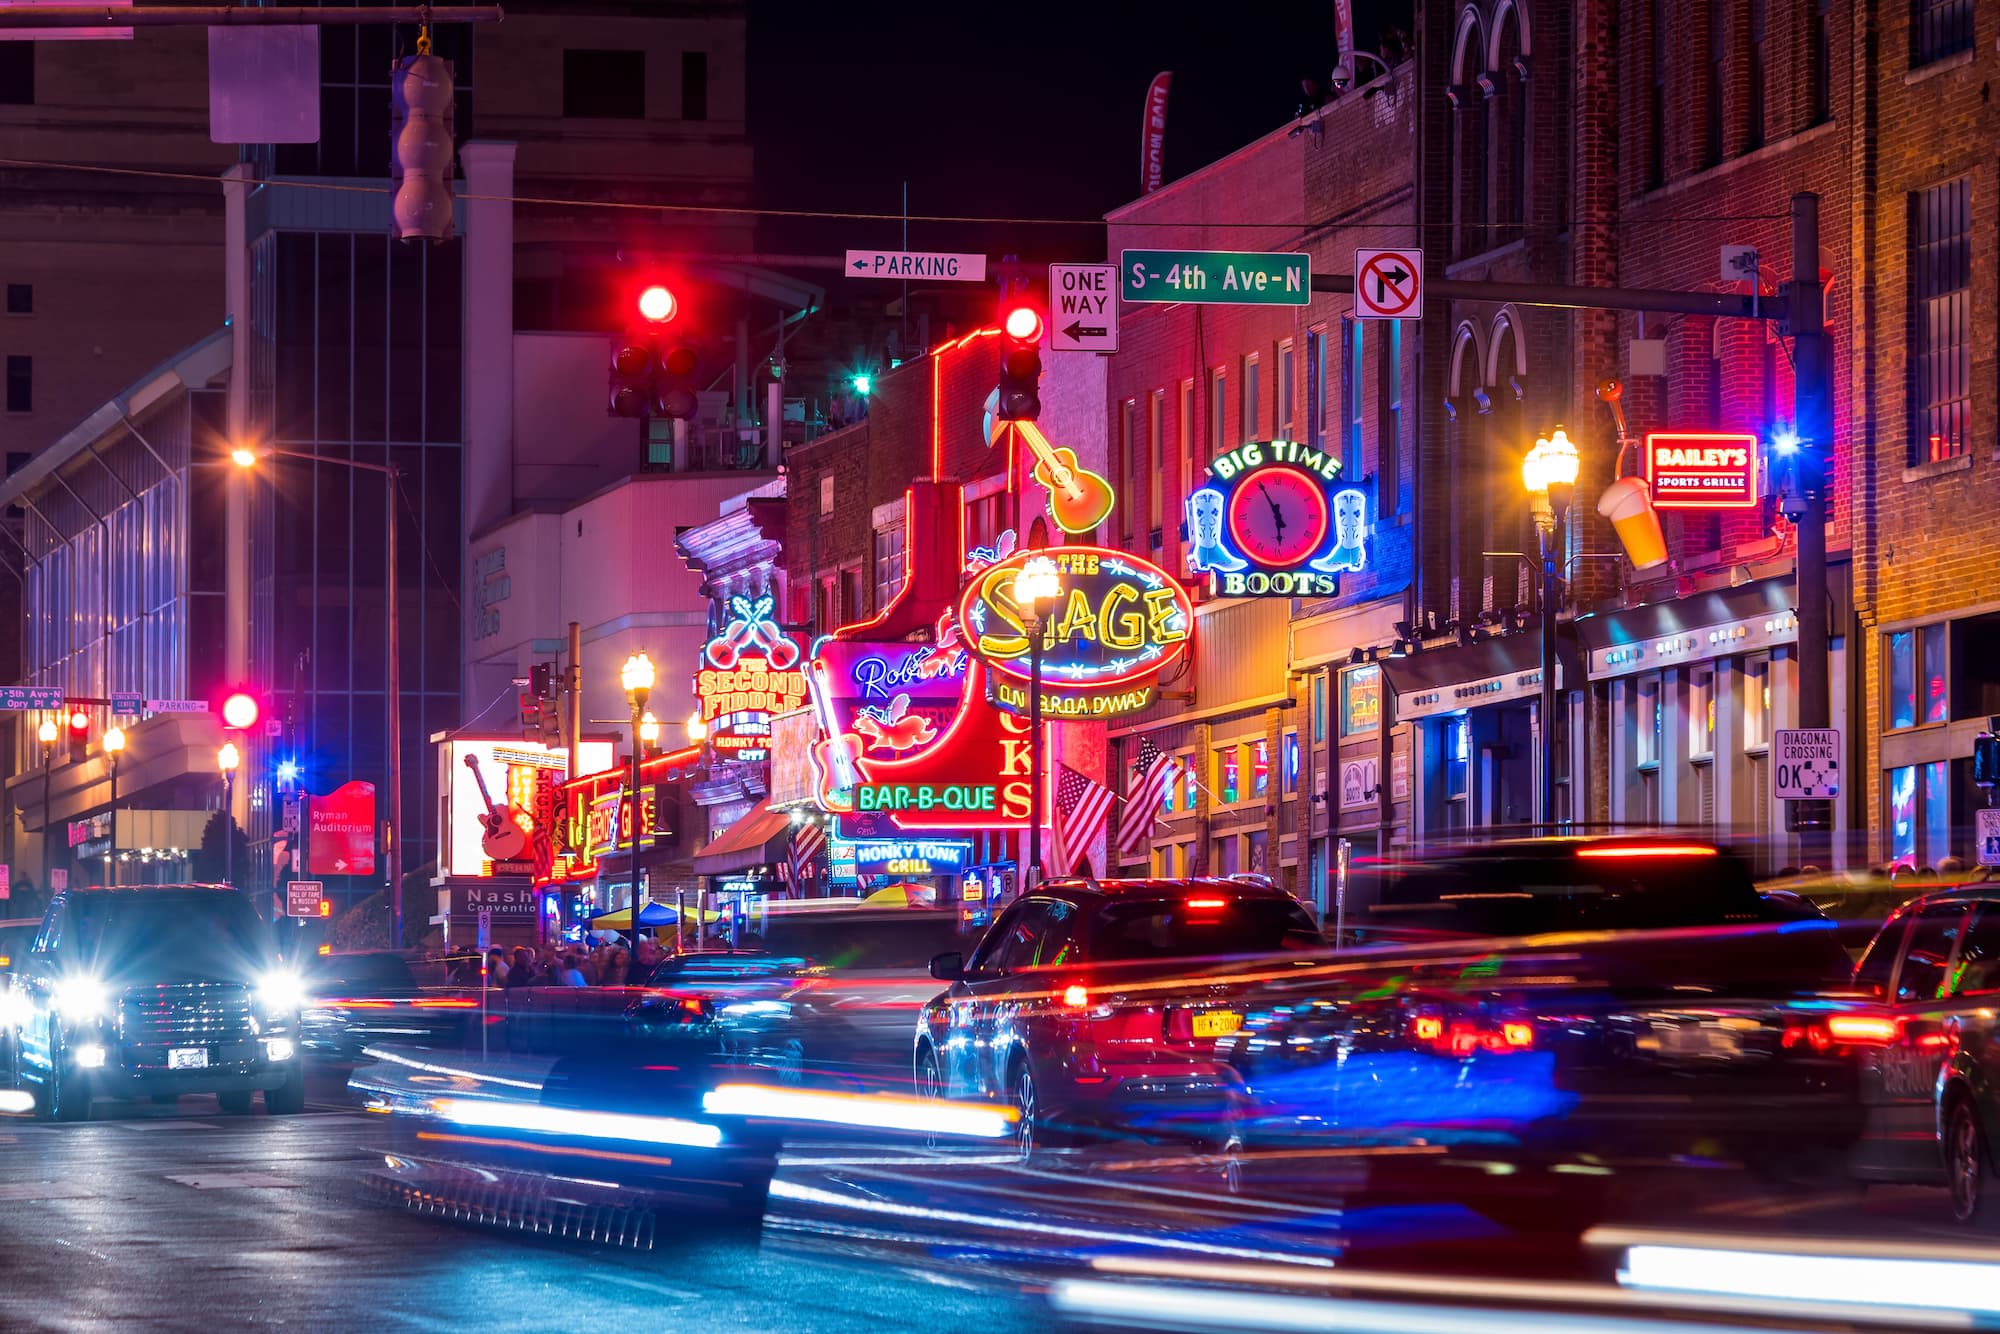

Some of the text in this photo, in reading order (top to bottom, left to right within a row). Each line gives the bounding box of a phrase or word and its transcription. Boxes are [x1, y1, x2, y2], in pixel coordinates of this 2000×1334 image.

[874, 254, 959, 277] PARKING
[1062, 271, 1108, 292] ONE
[1131, 262, 1302, 293] S-4th Ave-N
[1061, 295, 1108, 315] WAY
[1213, 440, 1343, 480] BIG TIME
[1655, 448, 1748, 467] BAILEY'S
[1657, 477, 1745, 487] SPORTS GRILLE
[1057, 553, 1100, 576] THE
[1223, 572, 1336, 594] BOOTS
[738, 658, 768, 672] THE
[698, 670, 807, 697] SECOND
[7, 699, 29, 709] Opry
[1000, 683, 1026, 708] ON
[159, 701, 197, 711] PARKING
[703, 691, 802, 721] FIDDLE
[715, 736, 773, 748] HONKY TO
[1784, 732, 1833, 745] DIAGONAL
[737, 749, 766, 761] CITY
[1784, 746, 1833, 759] CROSSING
[1778, 764, 1803, 788] OK
[858, 785, 997, 811] BAR-B-QUE
[313, 810, 349, 821] Ryman
[313, 822, 373, 833] Auditorium
[857, 844, 914, 863] HONKY
[917, 844, 961, 863] TONK
[887, 858, 933, 874] GRILL
[722, 882, 755, 891] ATM
[467, 888, 532, 904] Nash
[467, 903, 537, 913] Conventio
